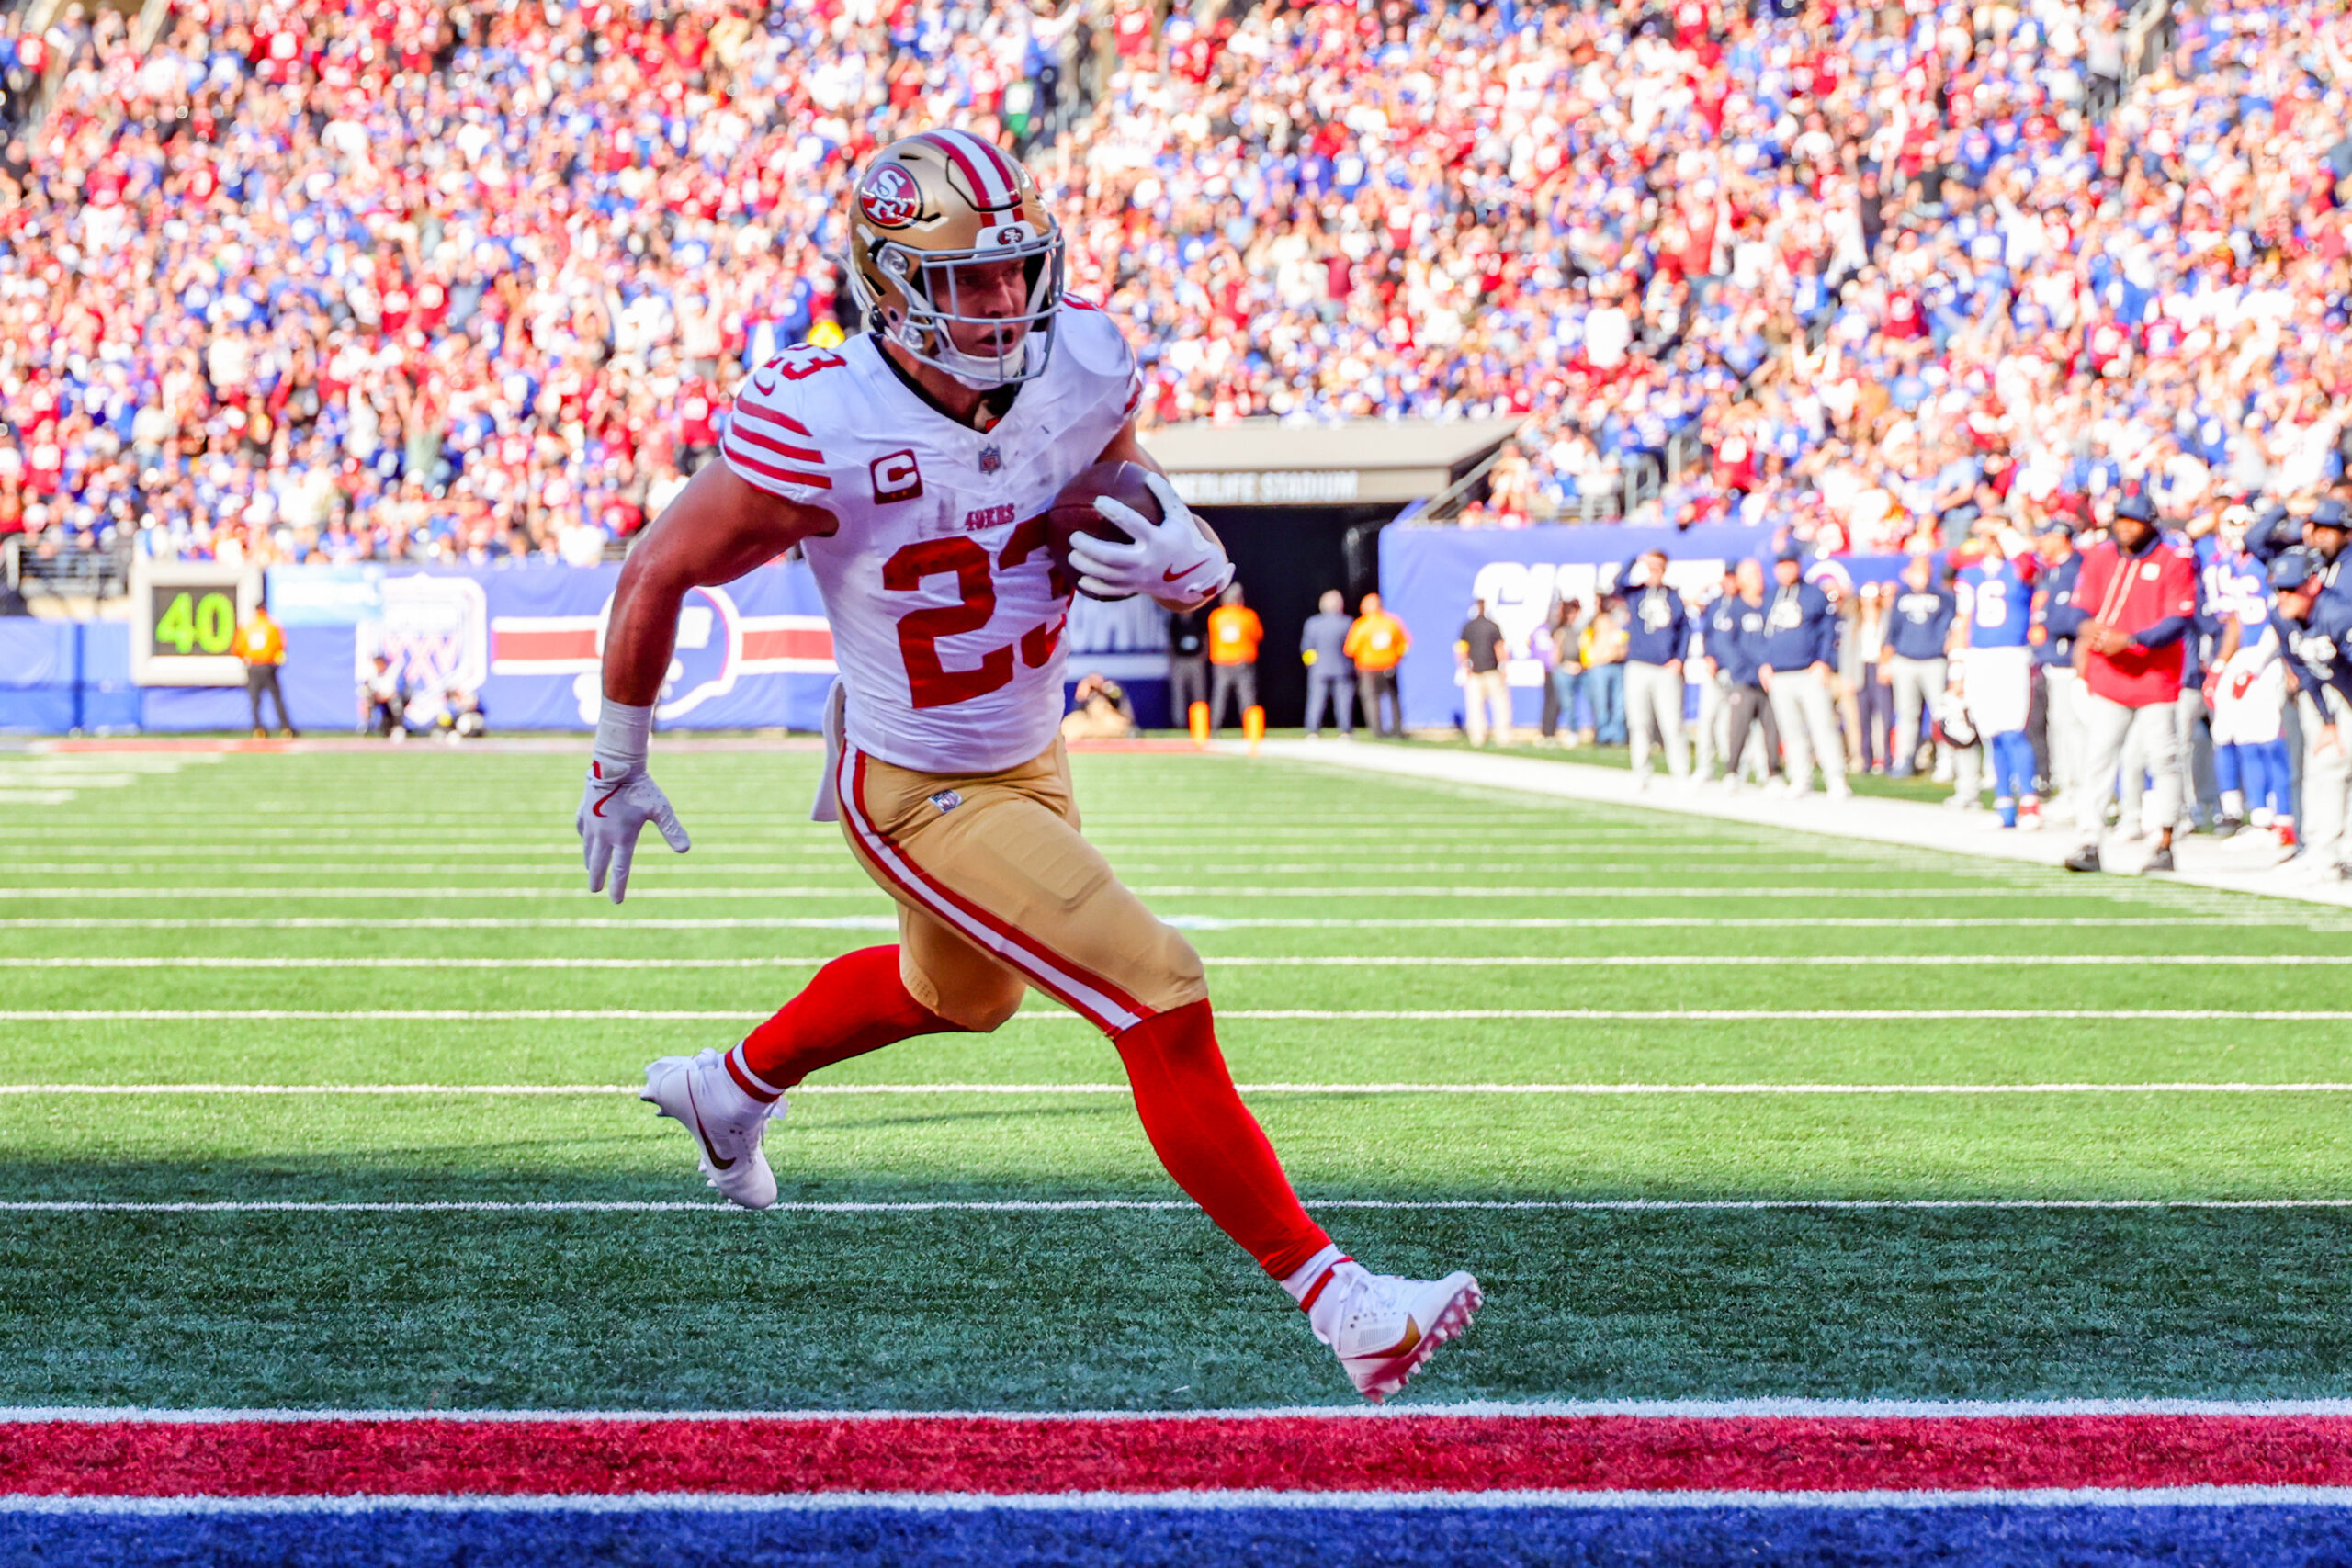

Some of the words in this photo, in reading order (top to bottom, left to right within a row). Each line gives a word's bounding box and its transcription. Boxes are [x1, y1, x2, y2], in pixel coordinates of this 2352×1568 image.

[874, 454, 918, 494] C
[1259, 470, 1359, 502] STADIUM
[964, 502, 1014, 532] 49ERS
[154, 591, 235, 655] 40
